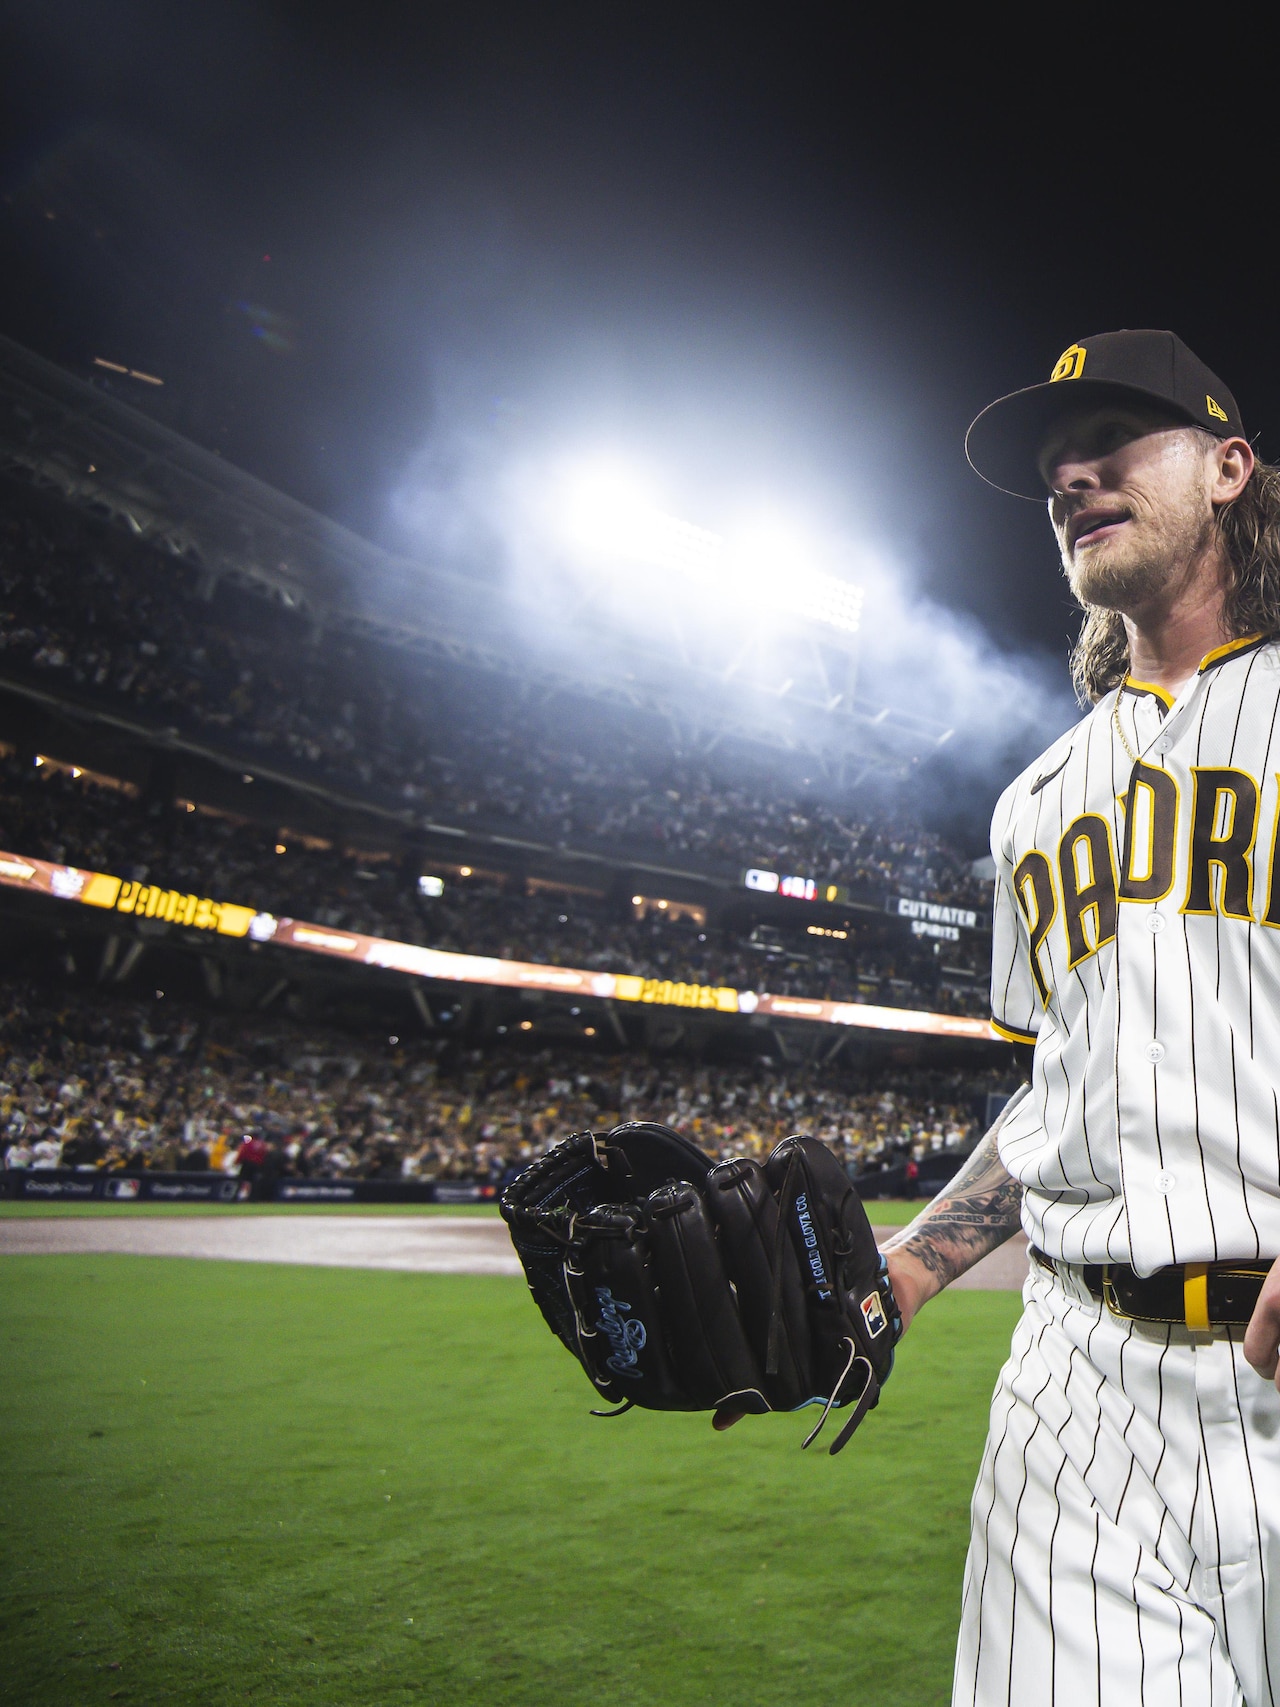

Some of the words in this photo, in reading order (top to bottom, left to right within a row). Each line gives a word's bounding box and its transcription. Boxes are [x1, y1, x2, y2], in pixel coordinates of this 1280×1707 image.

[899, 897, 977, 928] CUTWATER
[911, 920, 960, 941] SPIRITS
[798, 1211, 818, 1248] GLOVE
[928, 1213, 985, 1224] GENESIS
